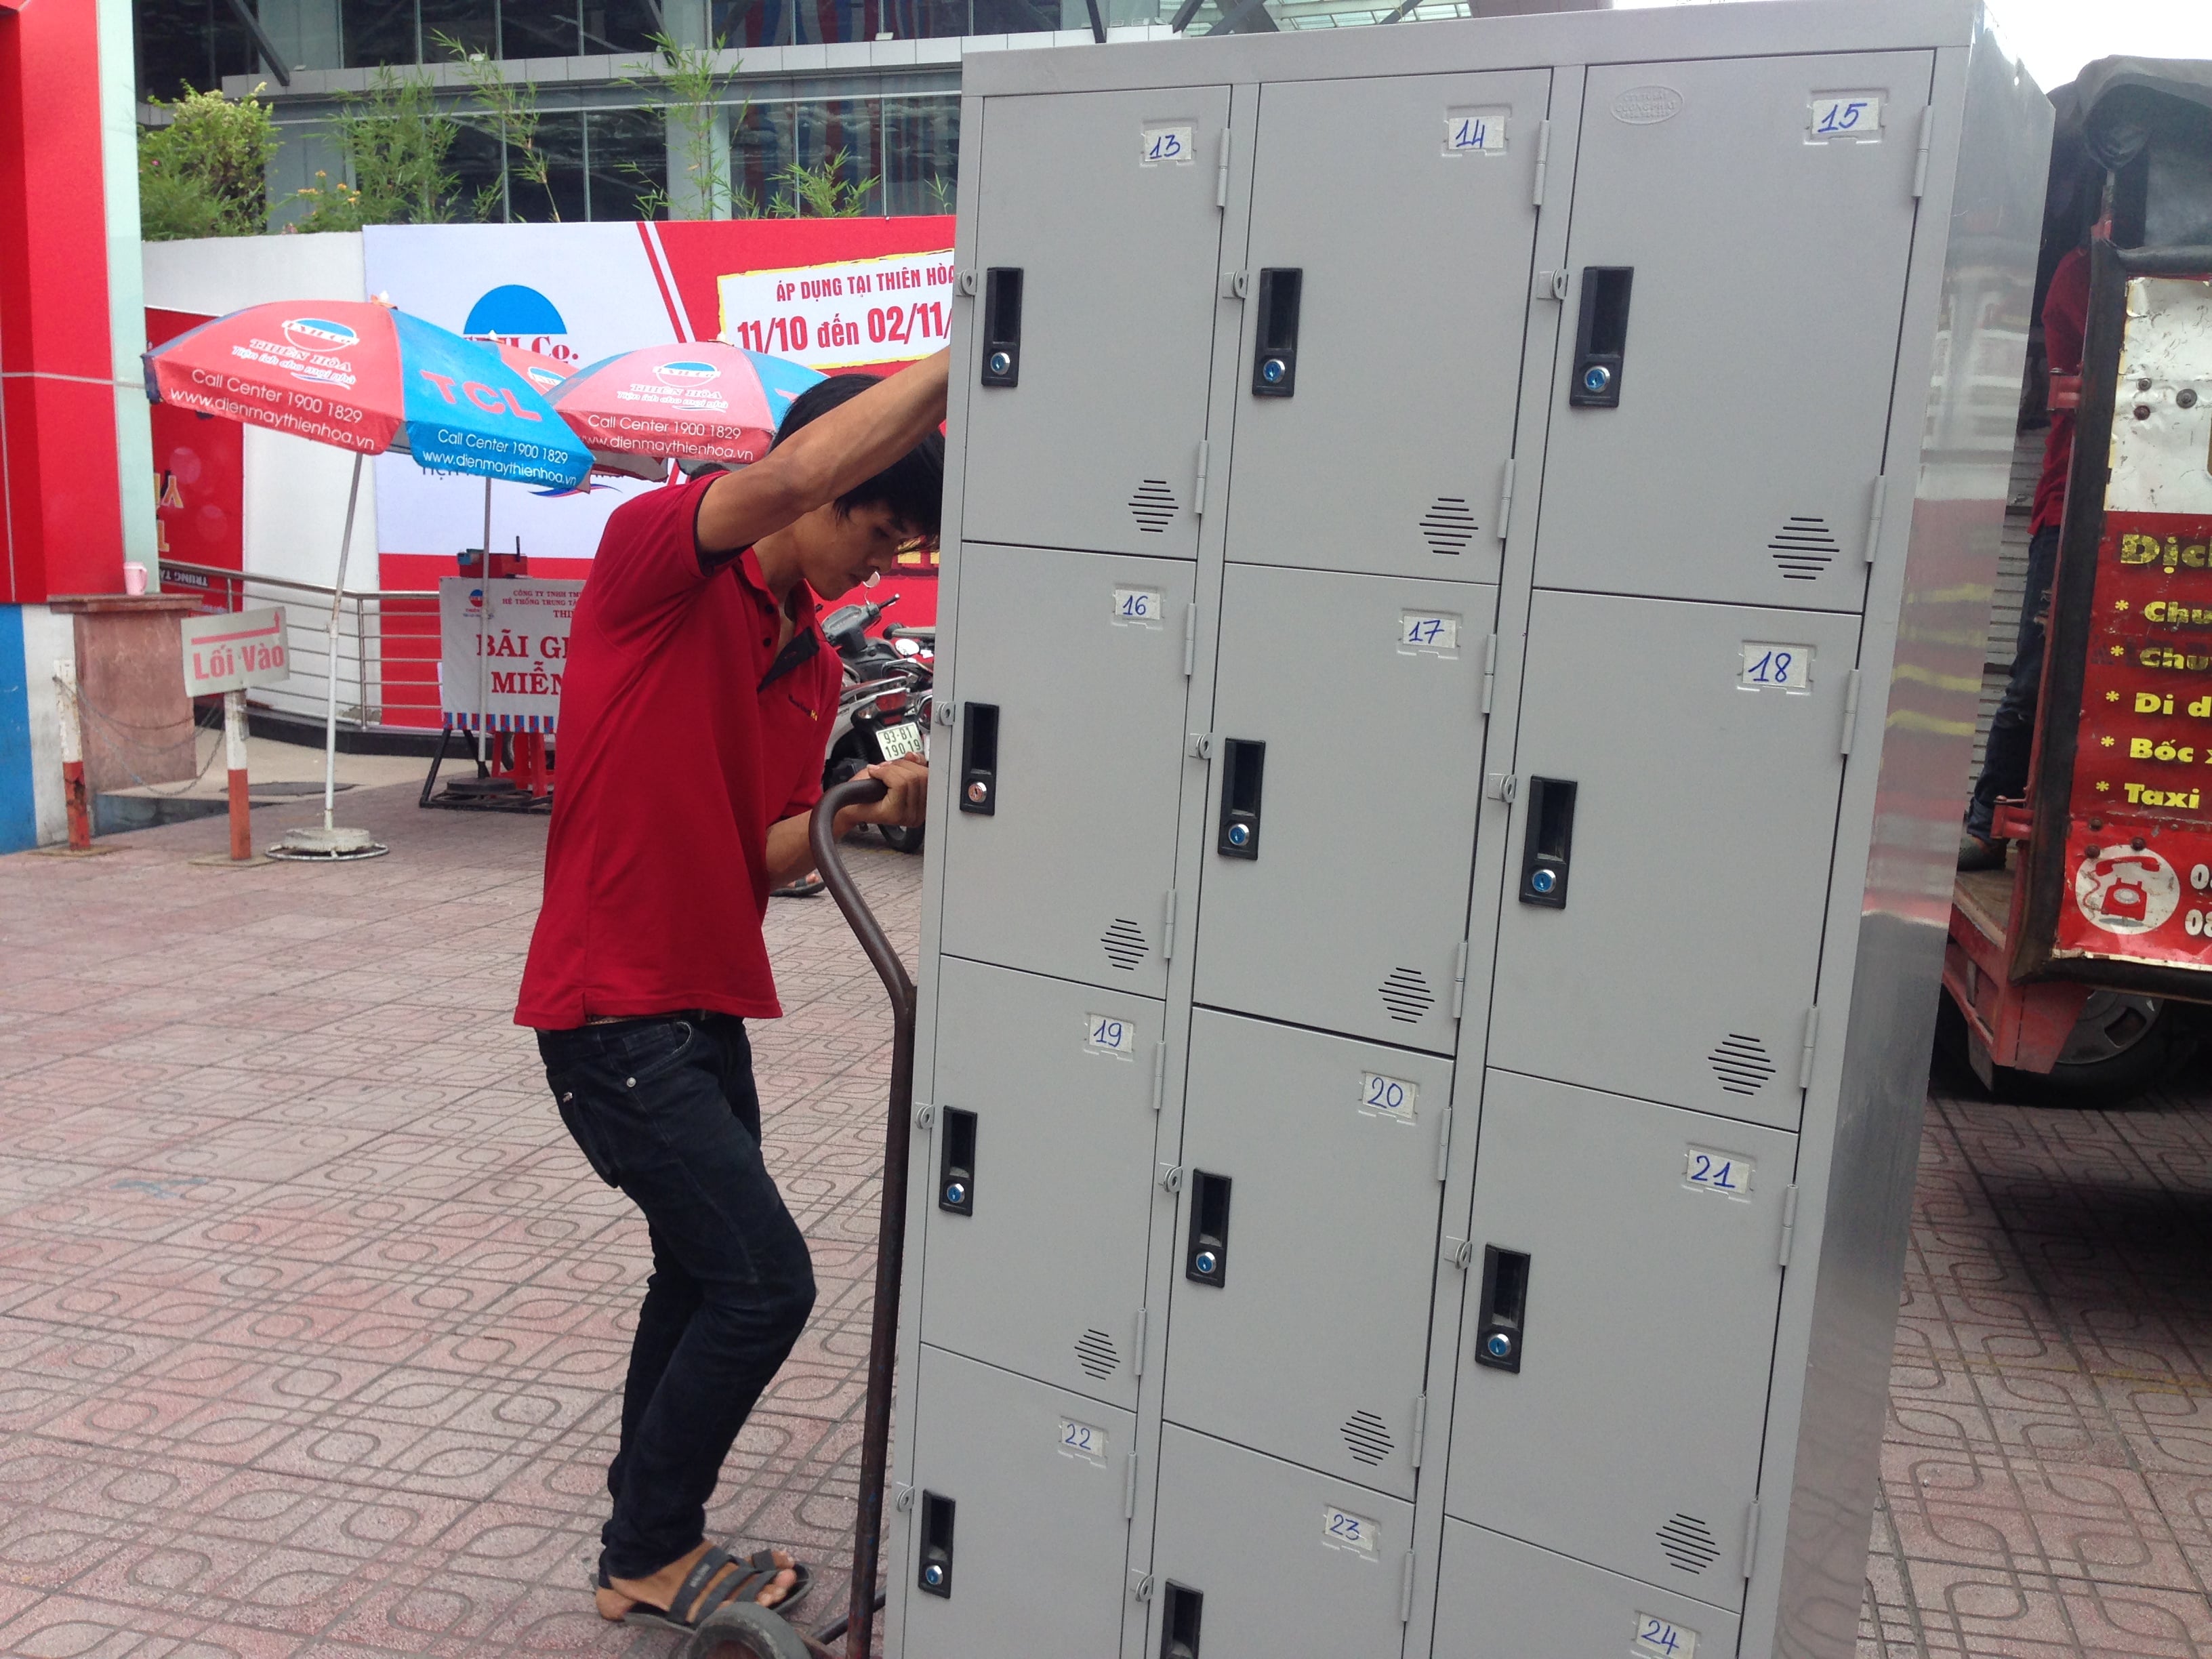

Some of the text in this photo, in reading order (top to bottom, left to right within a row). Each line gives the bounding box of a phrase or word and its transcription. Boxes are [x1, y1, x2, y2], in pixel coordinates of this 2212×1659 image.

[1817, 102, 1868, 133] 15
[1149, 134, 1181, 159] 13
[1455, 119, 1486, 148] 14
[776, 280, 796, 302] ÁP
[801, 276, 842, 303] DỤNG
[846, 274, 872, 298] TẠI
[876, 267, 922, 291] THIÊN
[737, 316, 808, 354] 11/10
[817, 313, 859, 348] đến
[192, 369, 363, 424] Call Center 1900 1829
[419, 369, 543, 422] TCL
[169, 388, 375, 451] www.dienmaythienhoa.vn
[588, 414, 741, 440] Call Center 1900 1829
[438, 429, 568, 464] Call Center 1900 1829
[422, 450, 577, 487] www.dienmaythienhoa.vn
[2121, 534, 2212, 574] Dịc
[1122, 595, 1148, 615] 16
[1408, 619, 1445, 644] 17
[192, 642, 285, 680] Lối Vào
[1748, 651, 1792, 683] 18
[2135, 692, 2174, 715] Di
[883, 726, 912, 744] 93-B1
[2129, 737, 2194, 762] Bốc
[2124, 783, 2200, 809] Taxi
[1093, 1019, 1122, 1048] 19
[1368, 1077, 1403, 1109] 20
[1692, 1155, 1736, 1188] 21
[1065, 1424, 1091, 1450] 22
[1330, 1514, 1359, 1540] 23
[1641, 1620, 1680, 1656] 24
